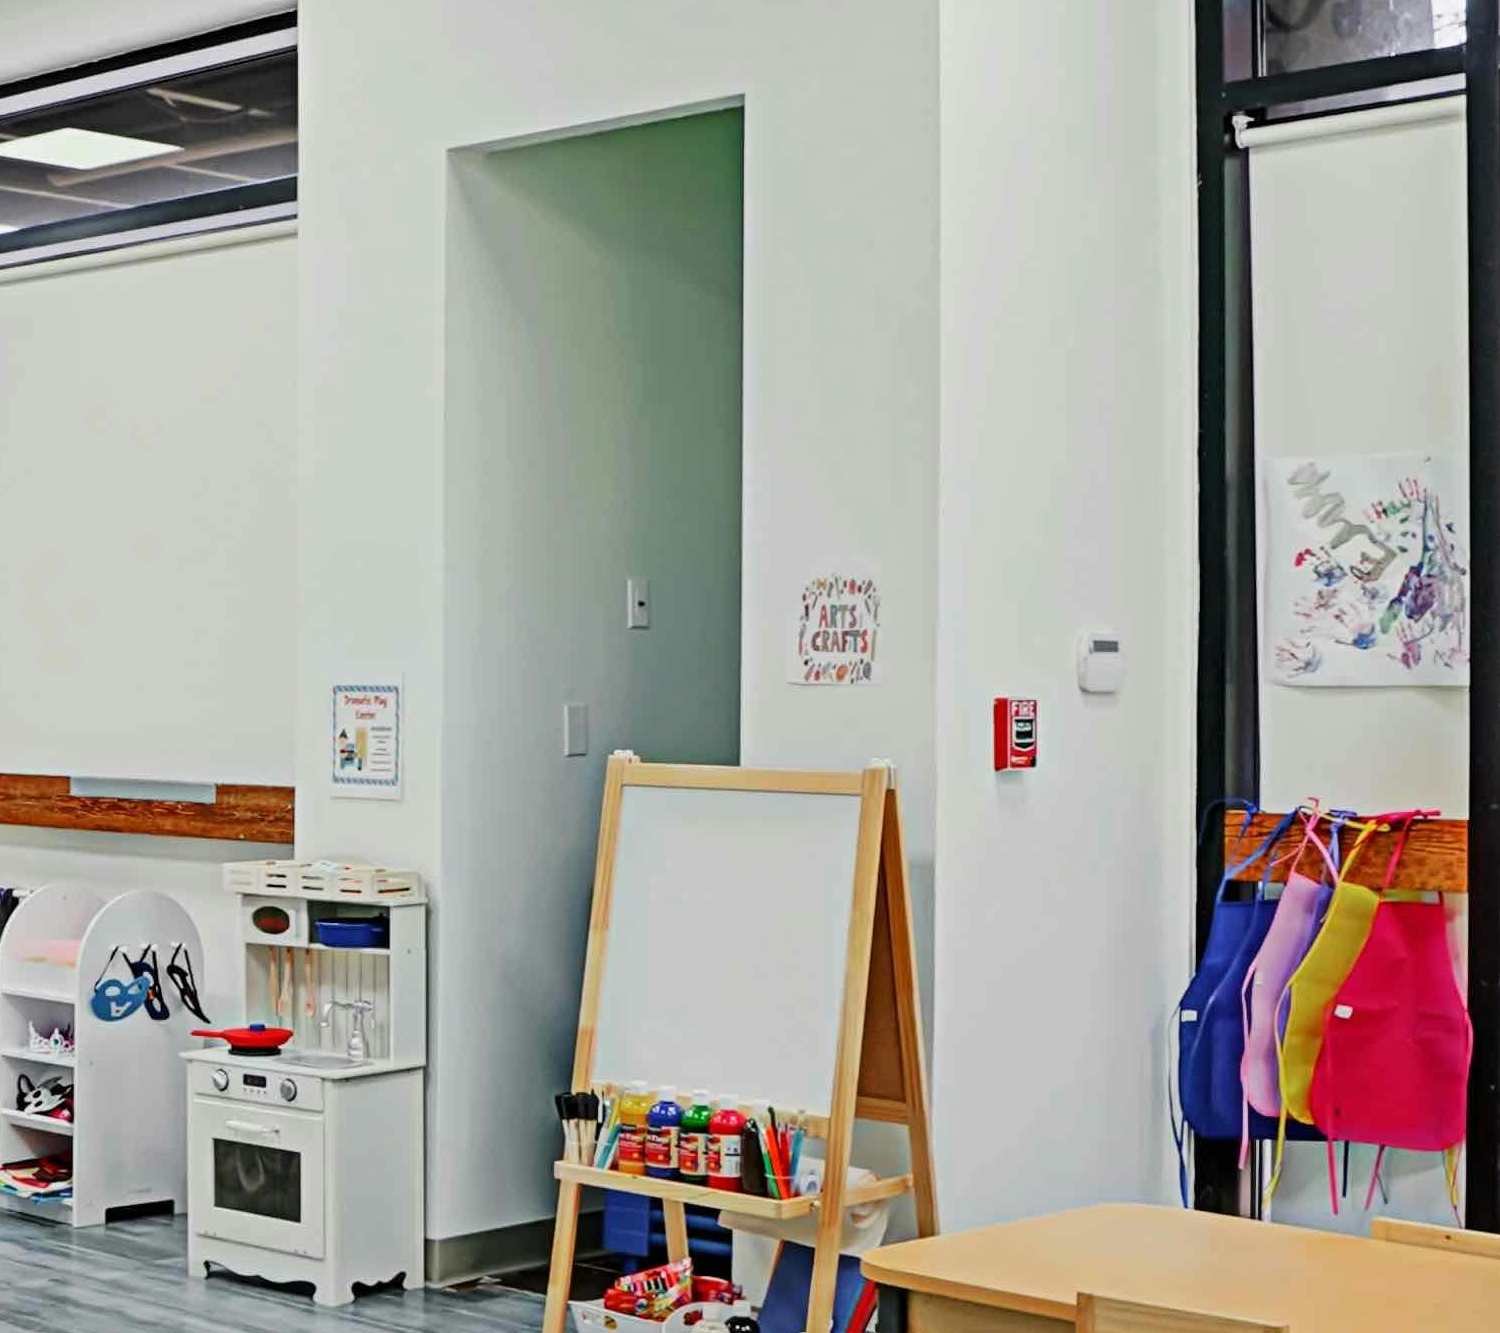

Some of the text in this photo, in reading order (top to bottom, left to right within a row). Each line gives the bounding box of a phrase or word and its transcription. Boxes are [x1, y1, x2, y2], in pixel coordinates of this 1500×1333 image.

[819, 604, 857, 628] ARTS
[811, 628, 868, 653] CRAFTS
[1011, 701, 1035, 716] FIRE
